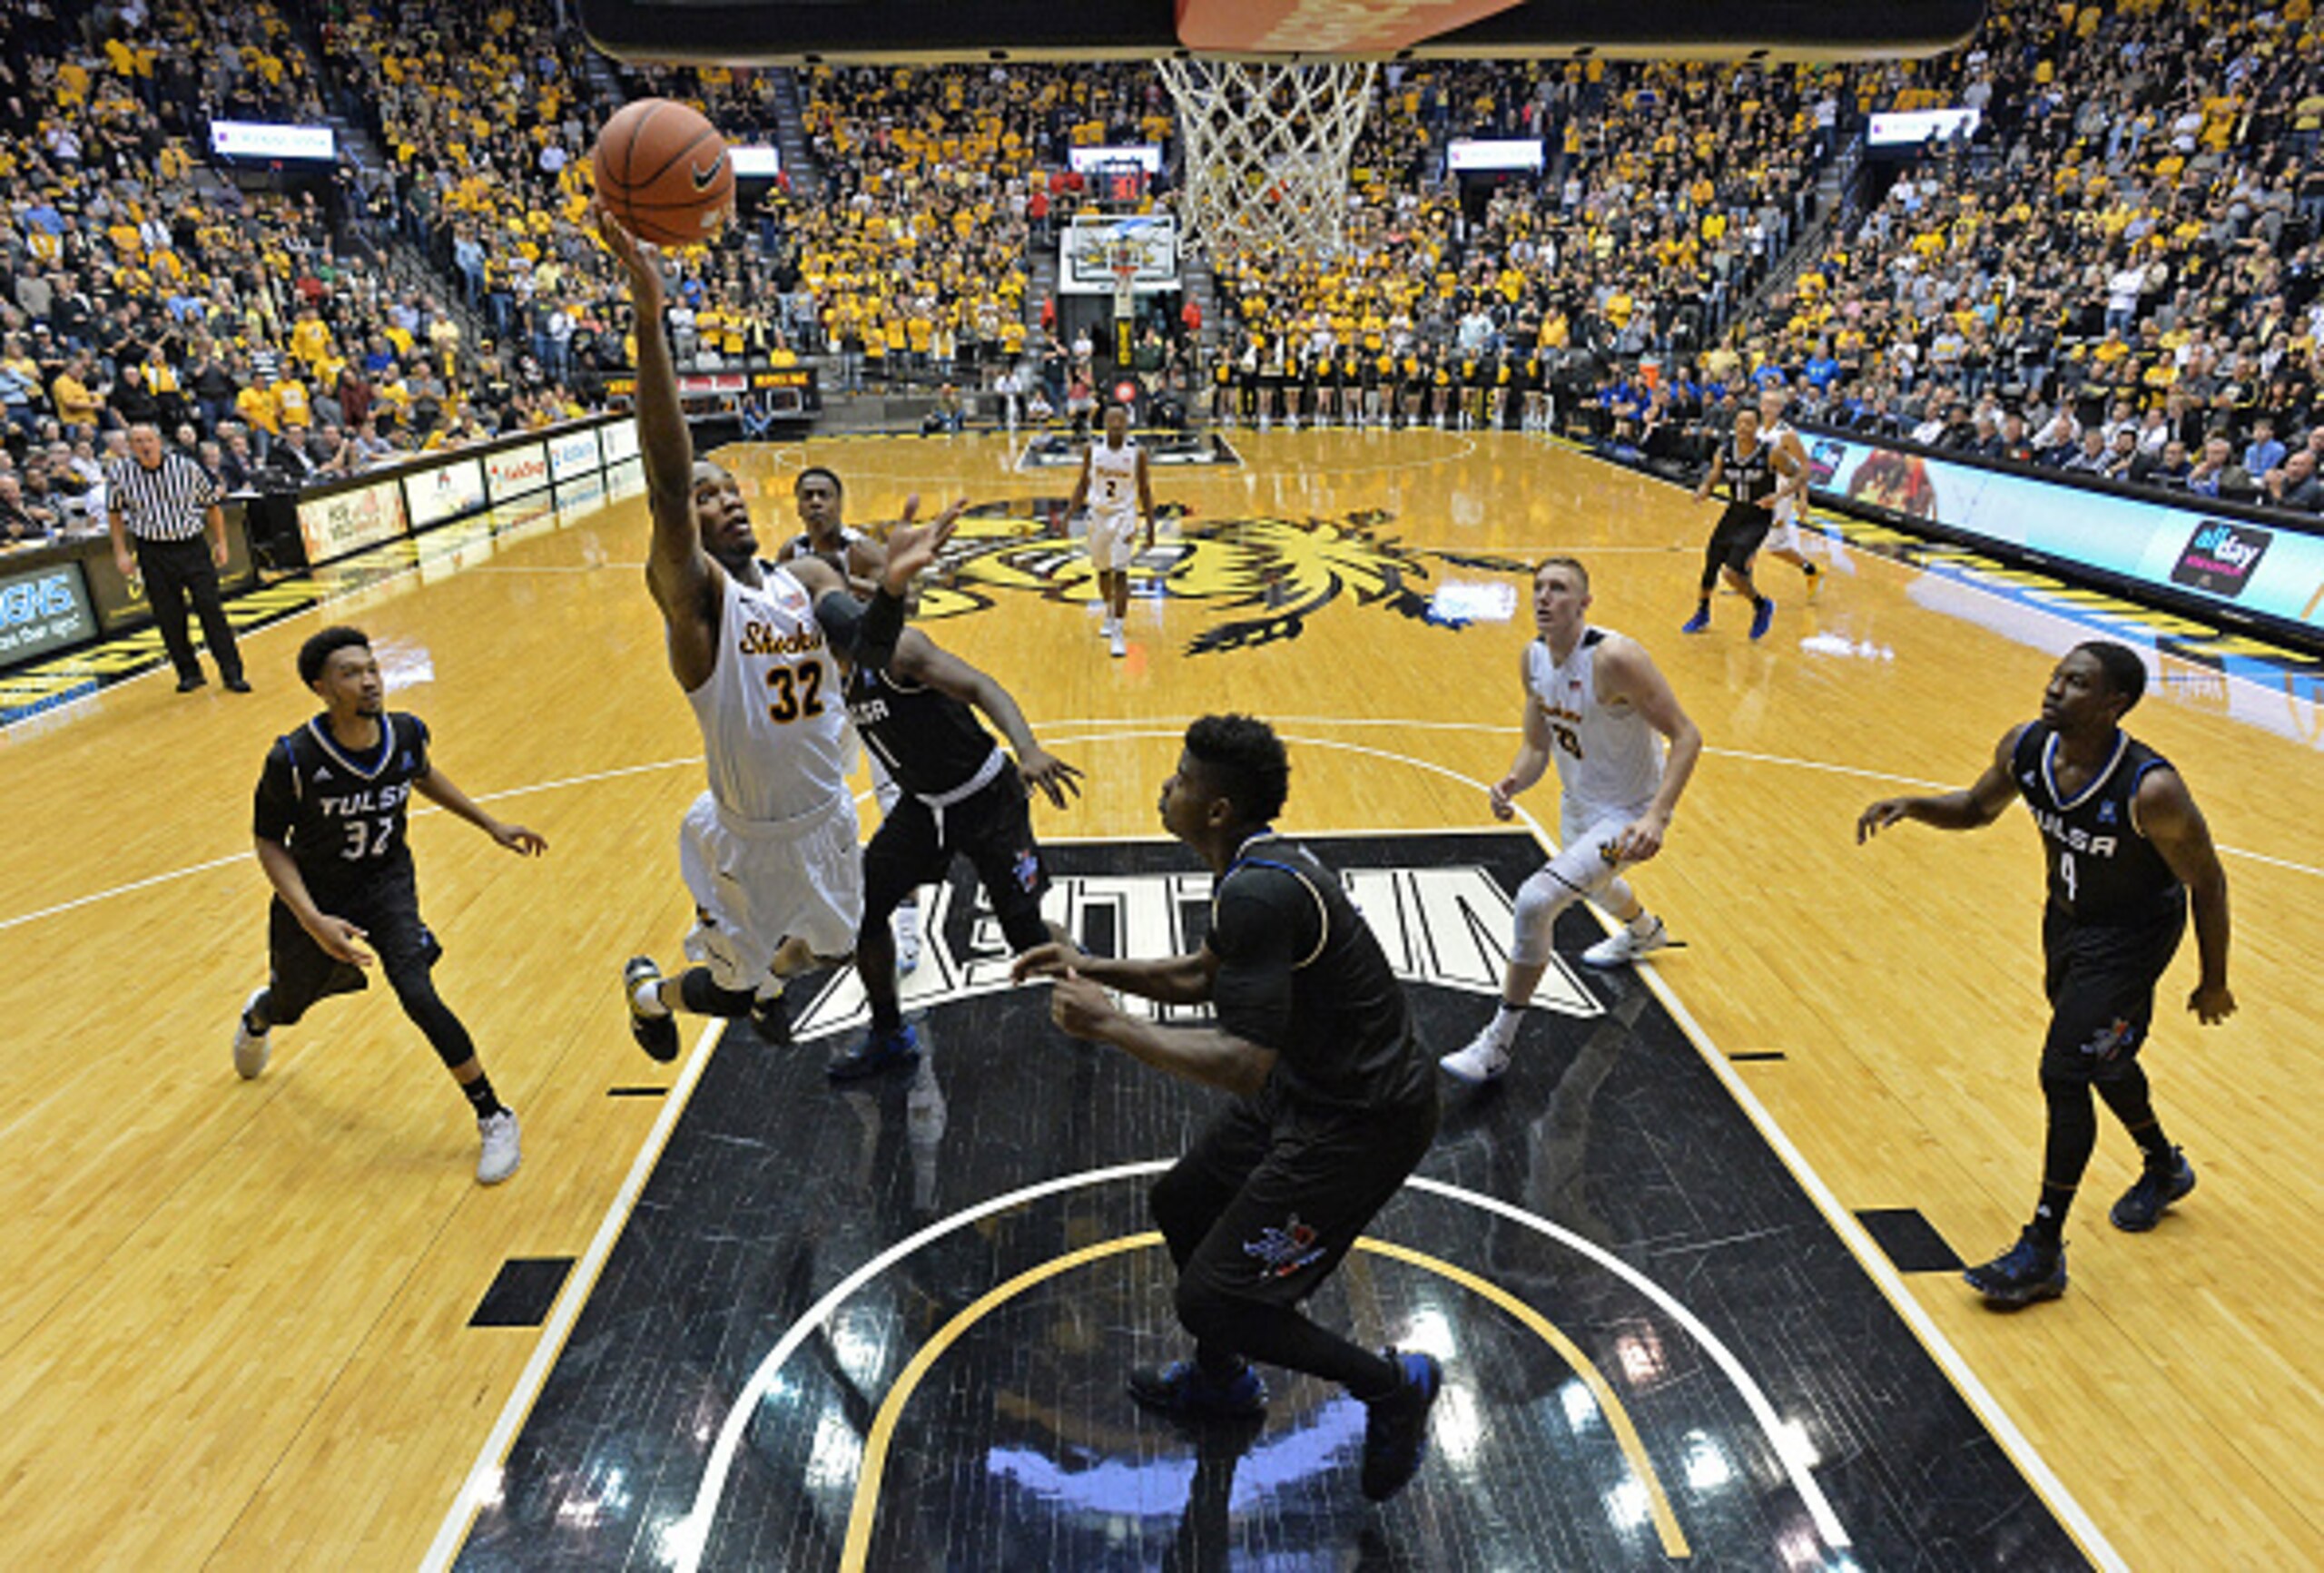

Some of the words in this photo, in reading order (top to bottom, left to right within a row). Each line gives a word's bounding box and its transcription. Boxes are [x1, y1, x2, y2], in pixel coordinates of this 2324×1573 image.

[766, 659, 825, 723] 32
[340, 816, 394, 861] 32
[2032, 807, 2118, 859] ULSA
